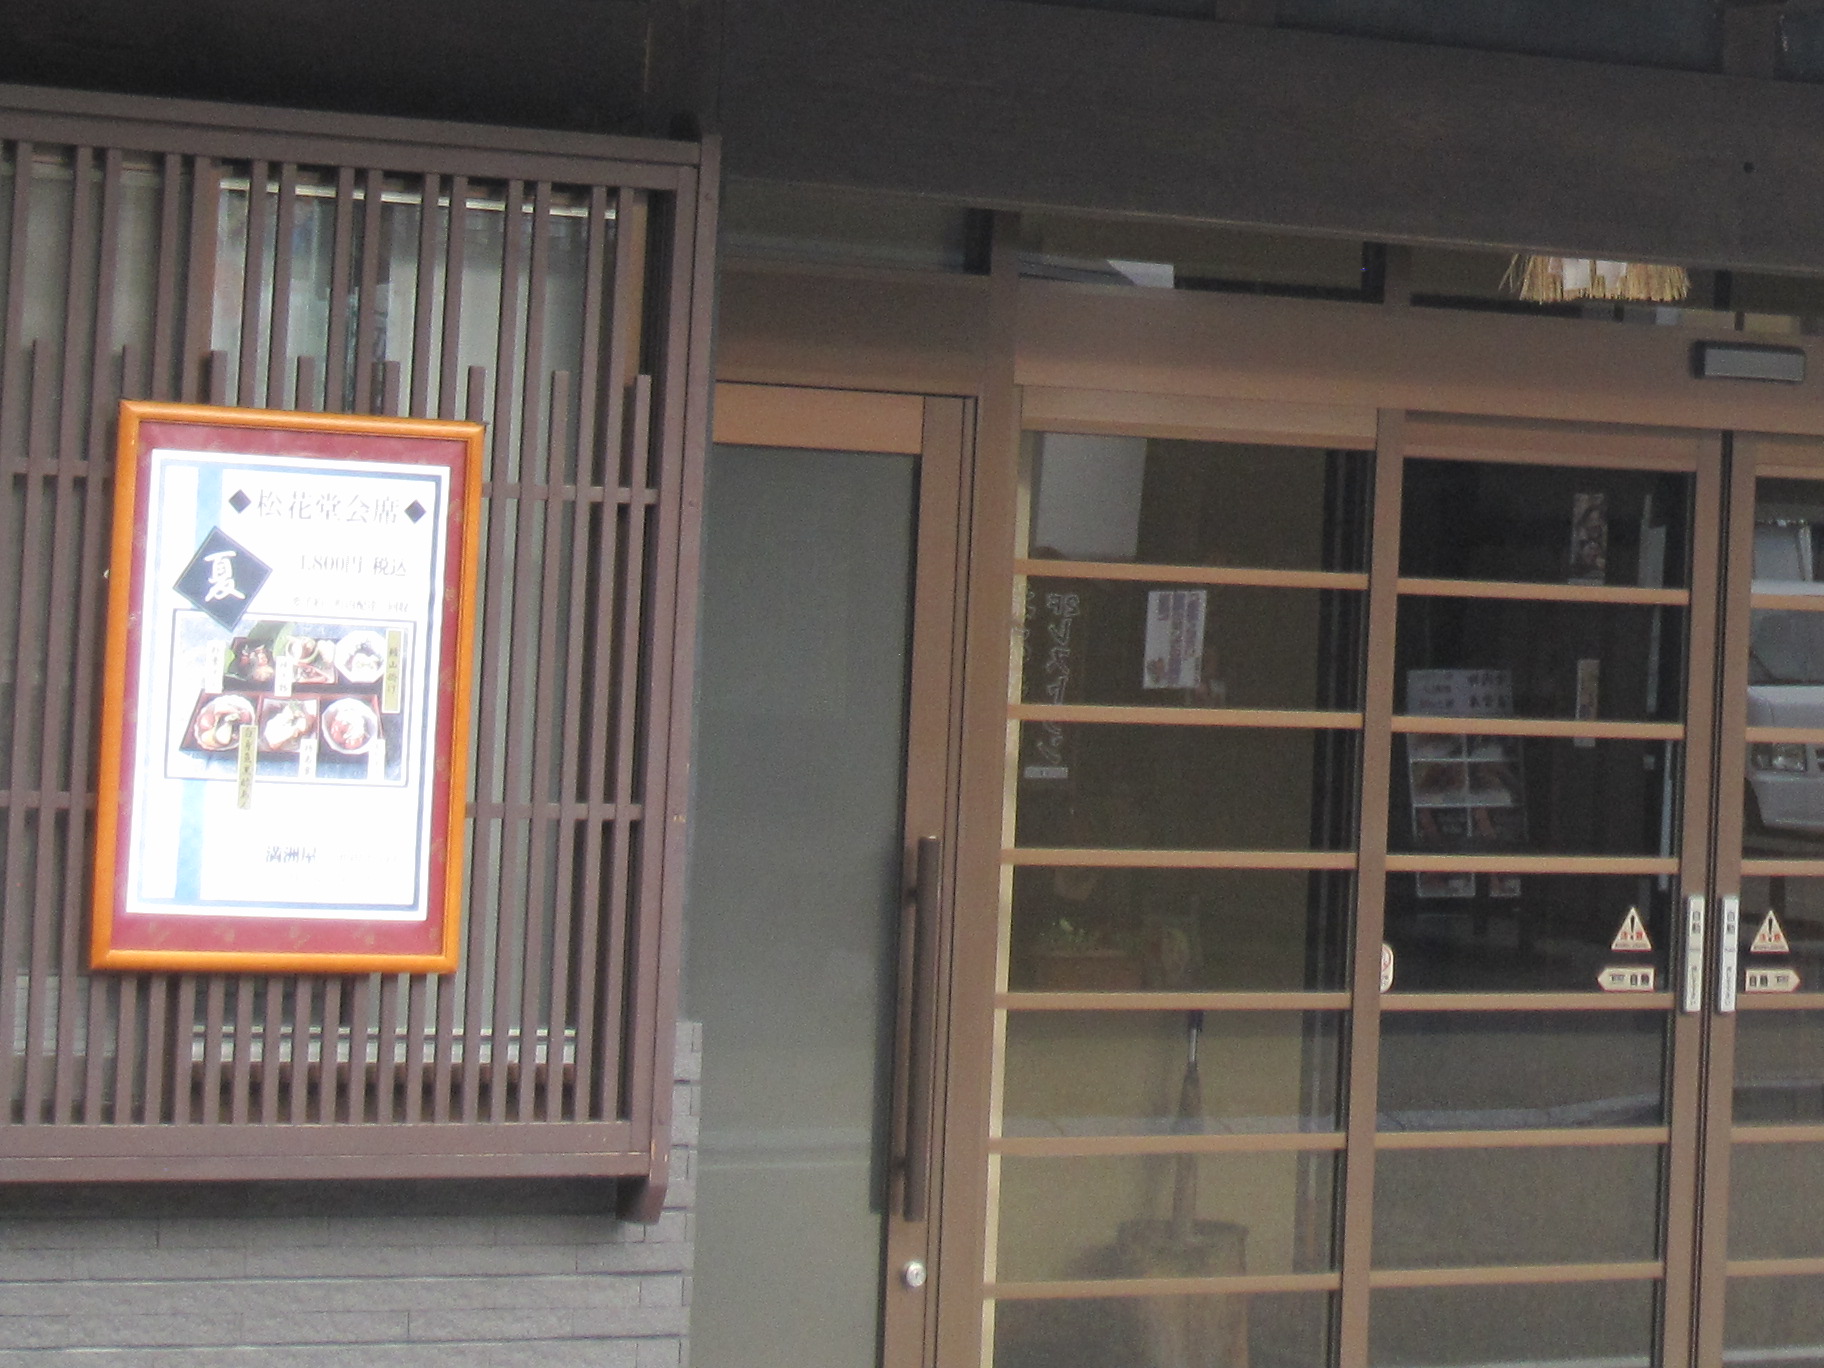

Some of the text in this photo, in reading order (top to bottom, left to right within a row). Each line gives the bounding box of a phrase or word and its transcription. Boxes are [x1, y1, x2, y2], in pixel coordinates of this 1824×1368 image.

[256, 488, 401, 525] 松花堂会席
[204, 550, 246, 602] 夏
